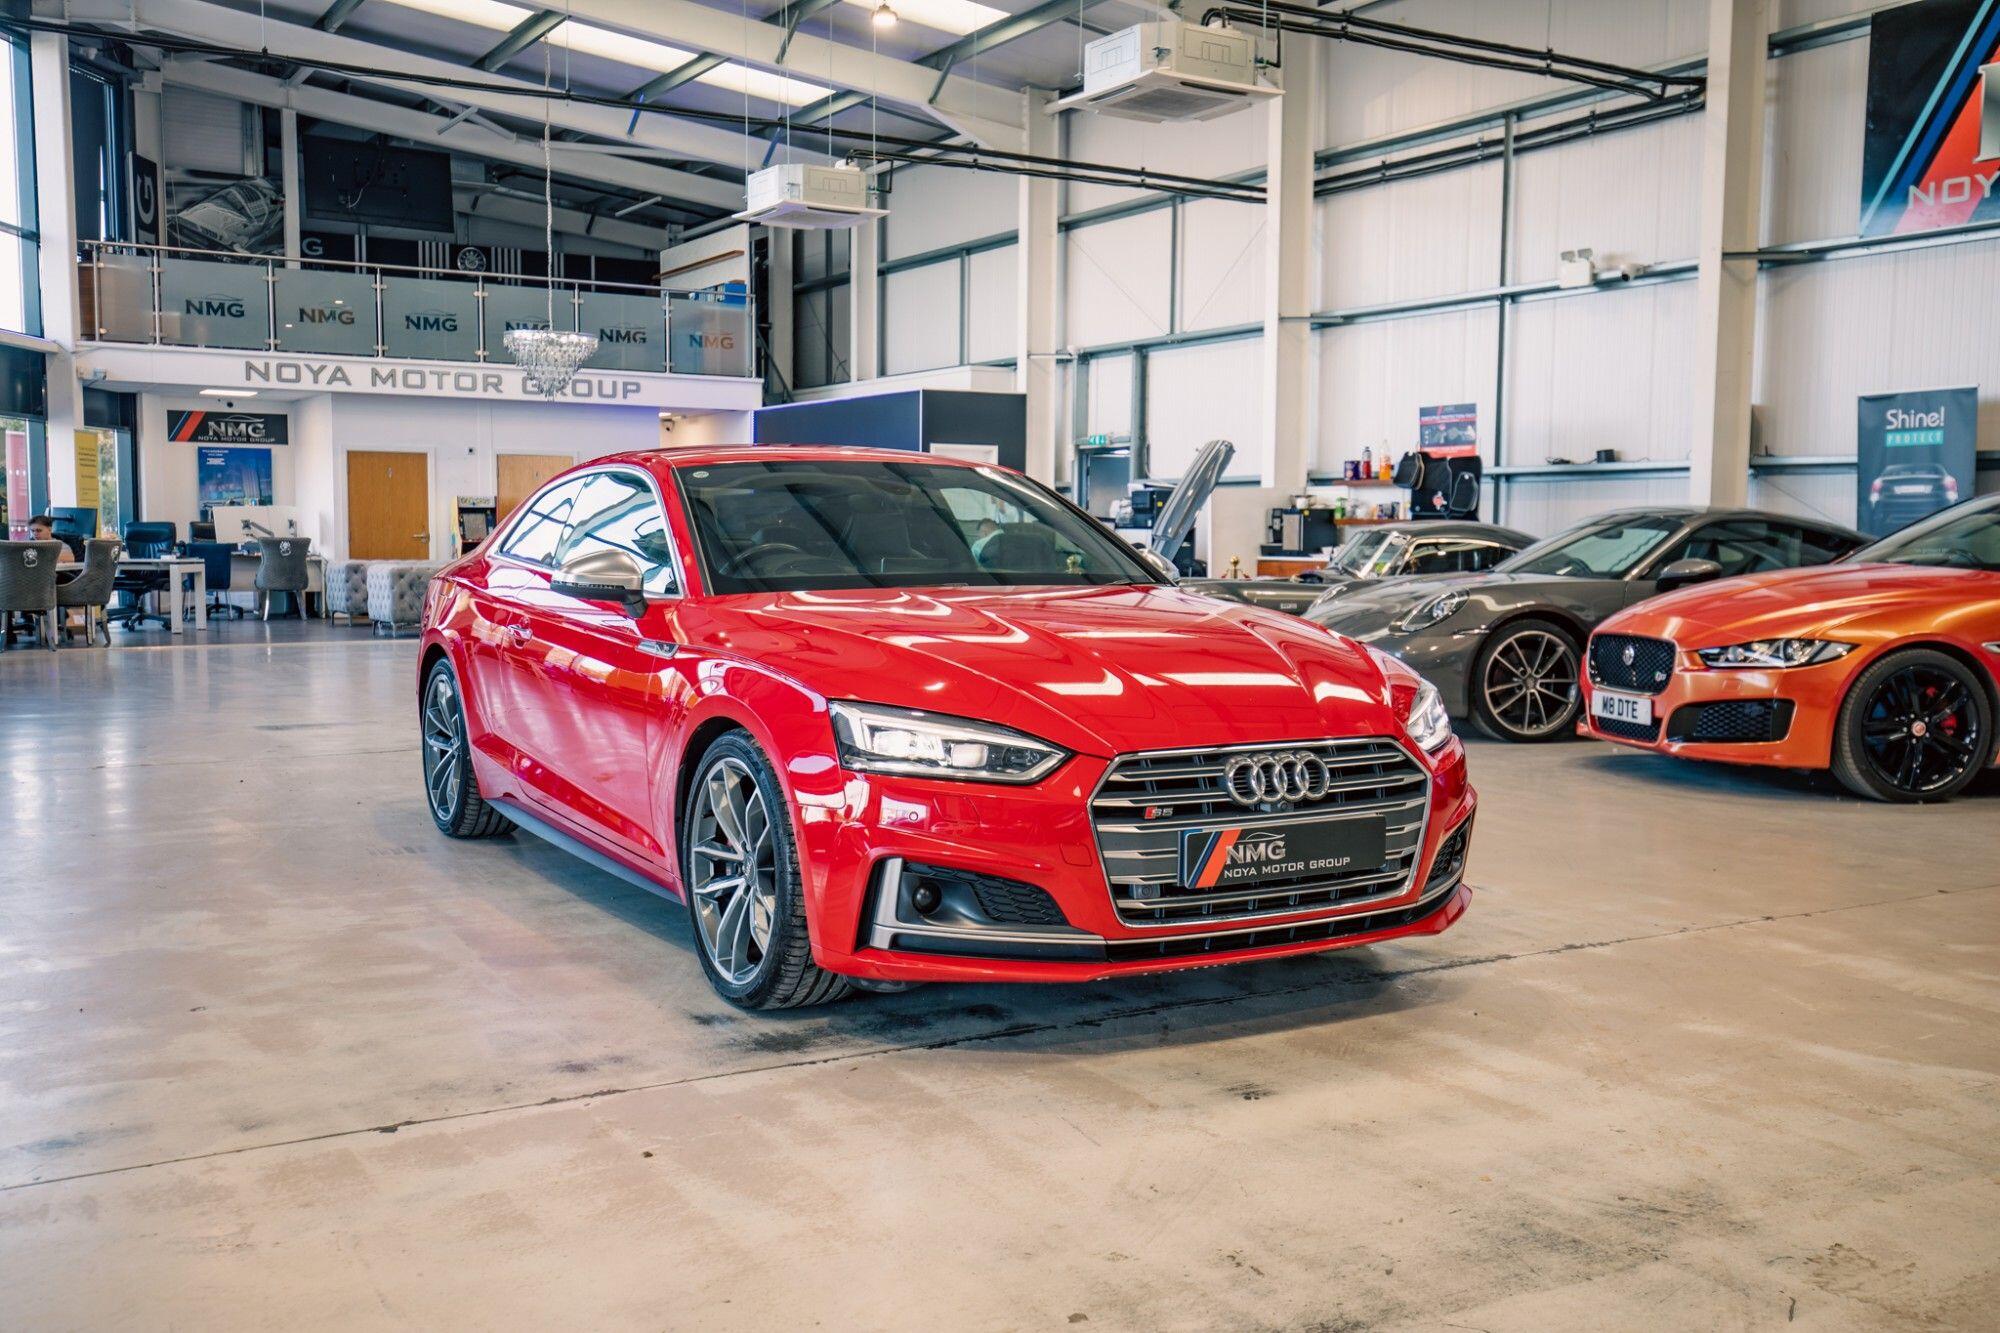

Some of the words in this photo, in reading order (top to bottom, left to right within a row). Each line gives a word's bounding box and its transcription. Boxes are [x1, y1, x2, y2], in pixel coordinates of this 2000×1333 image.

[185, 299, 245, 318] NMG
[299, 308, 355, 325] NMG
[405, 314, 458, 332] NMG
[600, 328, 647, 344] NMG
[689, 334, 734, 350] NMG
[245, 360, 352, 386] NOYA
[371, 367, 503, 393] MOTOR
[521, 375, 641, 399] GOUP
[1886, 406, 1945, 430] Shine!
[207, 421, 265, 437] NMG
[1617, 698, 1639, 719] DTE
[1225, 840, 1286, 866] NMG
[1224, 866, 1258, 879] NOYA
[1261, 861, 1305, 874] MOTOR
[1309, 856, 1351, 869] GROUP
